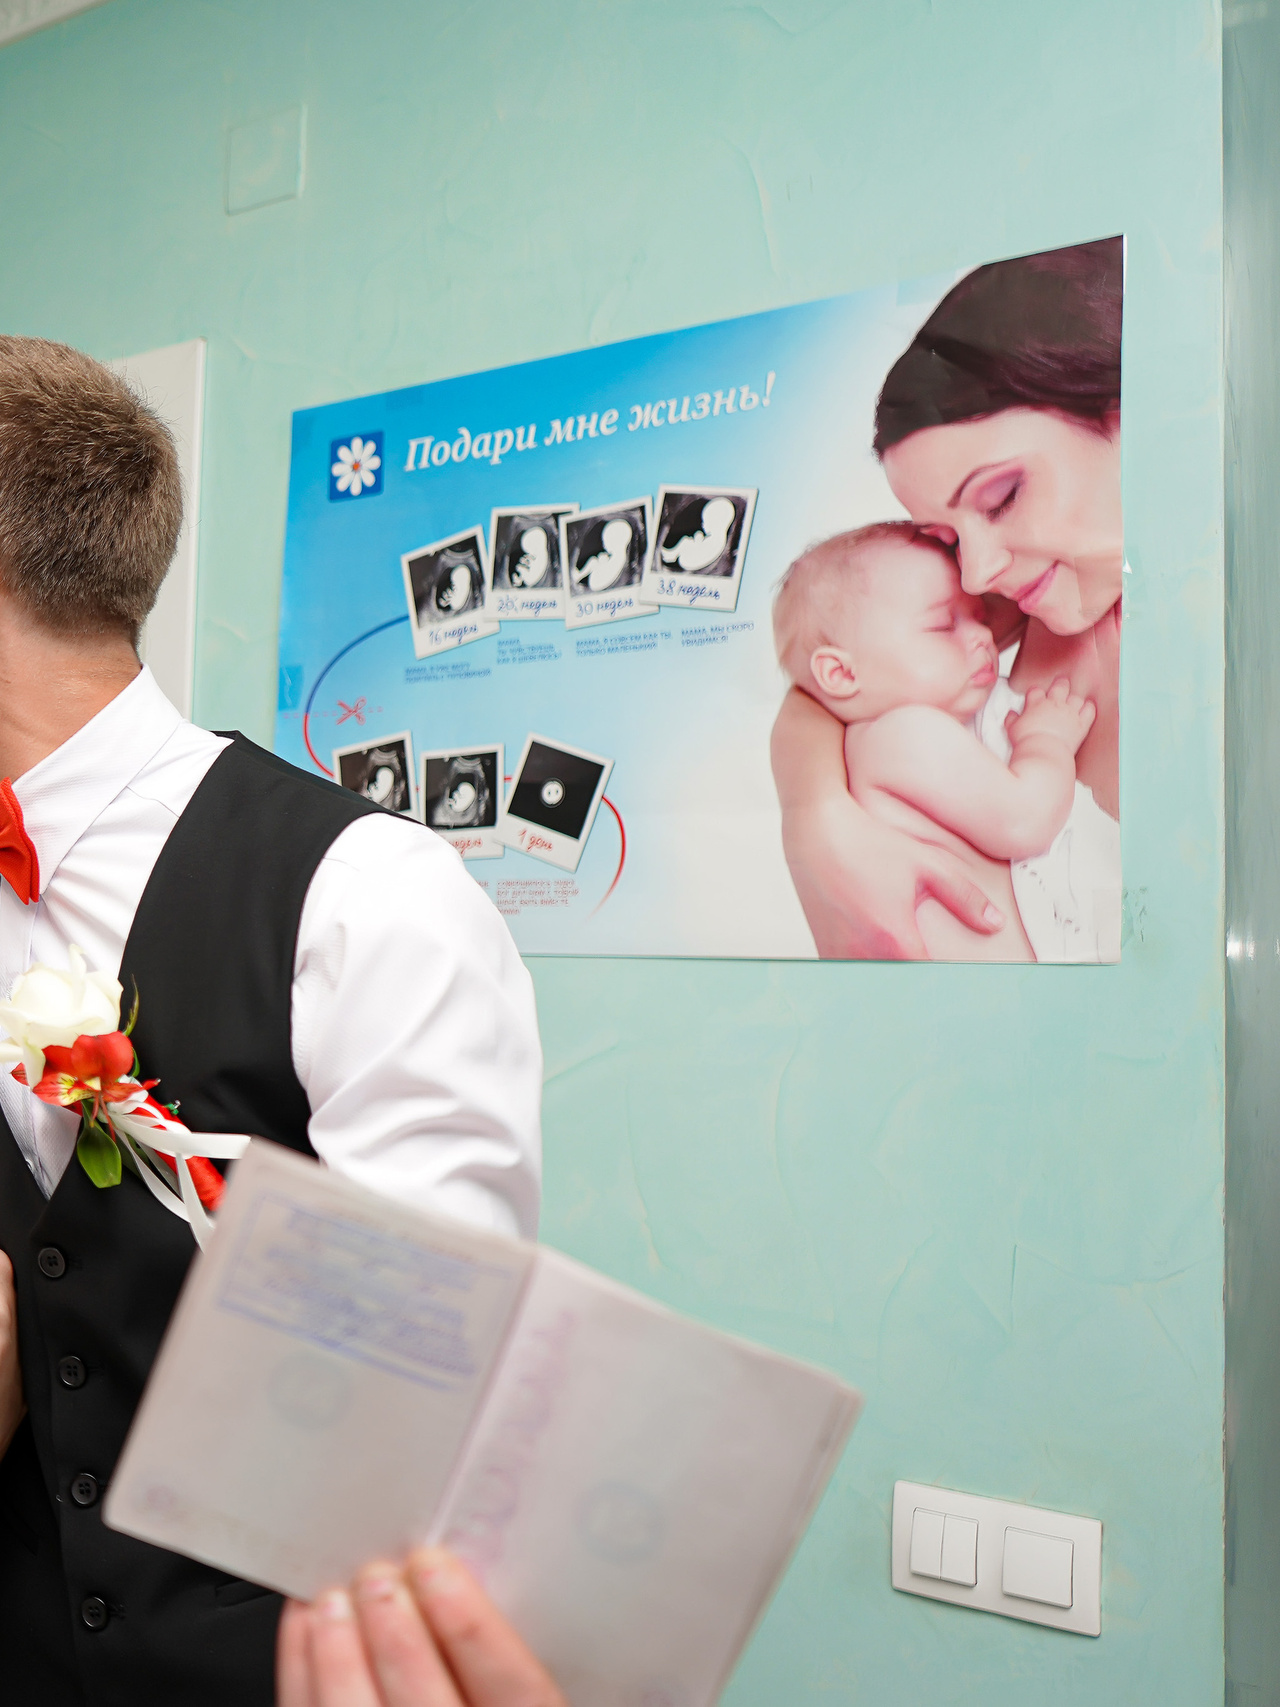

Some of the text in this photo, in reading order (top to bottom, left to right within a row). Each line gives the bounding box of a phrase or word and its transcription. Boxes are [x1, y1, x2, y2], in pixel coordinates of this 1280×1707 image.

[404, 370, 777, 472] Подари мне жизнь!
[656, 577, 676, 595] 38
[576, 601, 594, 618] 30
[518, 828, 526, 844] 1
